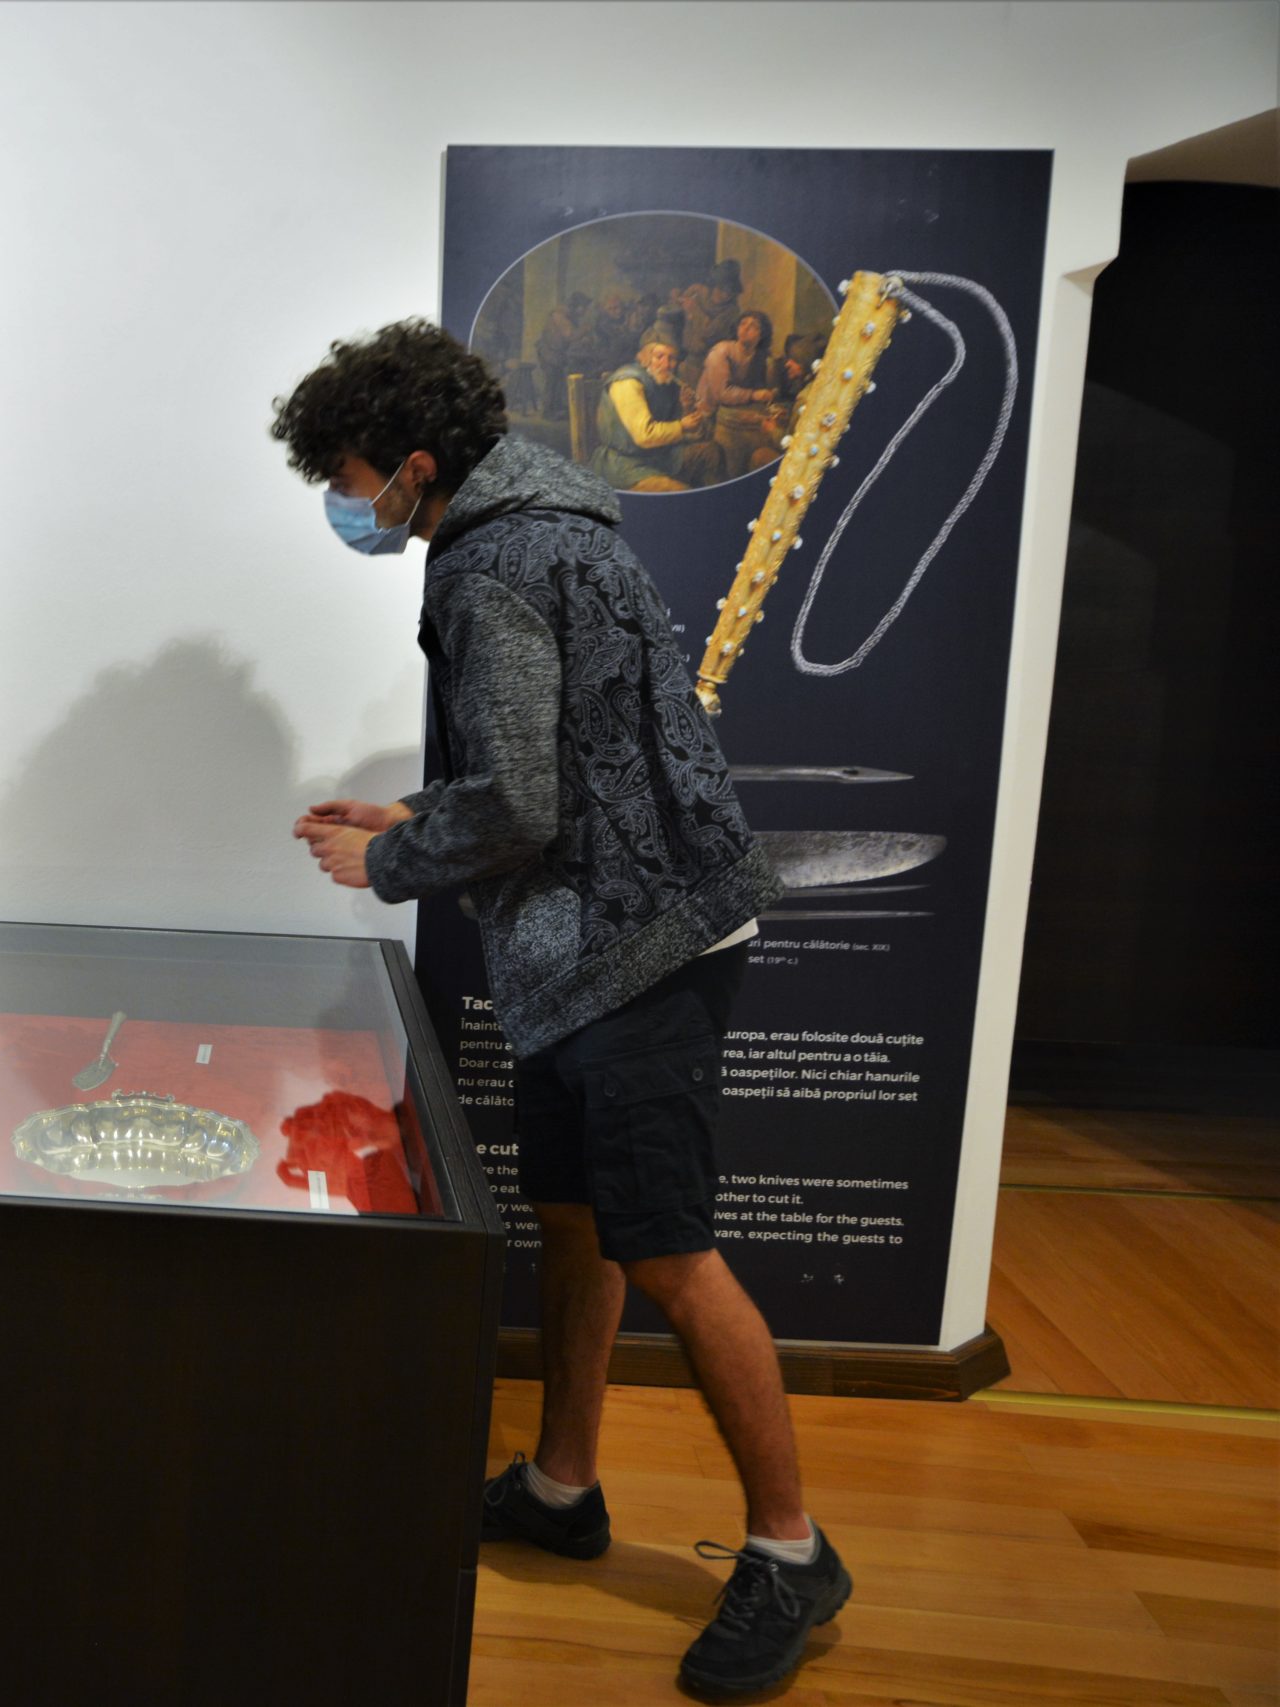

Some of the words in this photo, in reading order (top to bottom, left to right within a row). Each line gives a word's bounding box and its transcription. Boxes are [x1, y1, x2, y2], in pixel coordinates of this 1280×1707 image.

[770, 1032, 799, 1041] erau
[801, 1030, 849, 1042] folosite
[801, 1069, 826, 1079] Nici
[829, 1070, 863, 1080] chiar
[865, 1071, 920, 1082] hanurile
[823, 1089, 876, 1101] propriul
[878, 1090, 896, 1100] lor
[898, 1092, 918, 1101] set
[731, 1174, 756, 1184] two
[759, 1174, 800, 1185] knives
[801, 1178, 834, 1186] were
[836, 1178, 908, 1189] sometimes
[715, 1192, 750, 1202] other
[752, 1193, 766, 1203] to
[767, 1194, 789, 1203] cut
[791, 1194, 804, 1204] it.
[740, 1211, 753, 1220] at
[756, 1211, 778, 1221] the
[780, 1212, 813, 1222] table
[816, 1212, 834, 1223] for
[836, 1214, 858, 1224] the
[860, 1217, 904, 1227] guests.
[748, 1230, 813, 1243] expecting
[817, 1231, 839, 1242] the
[842, 1234, 885, 1244] guests
[889, 1235, 903, 1244] to
